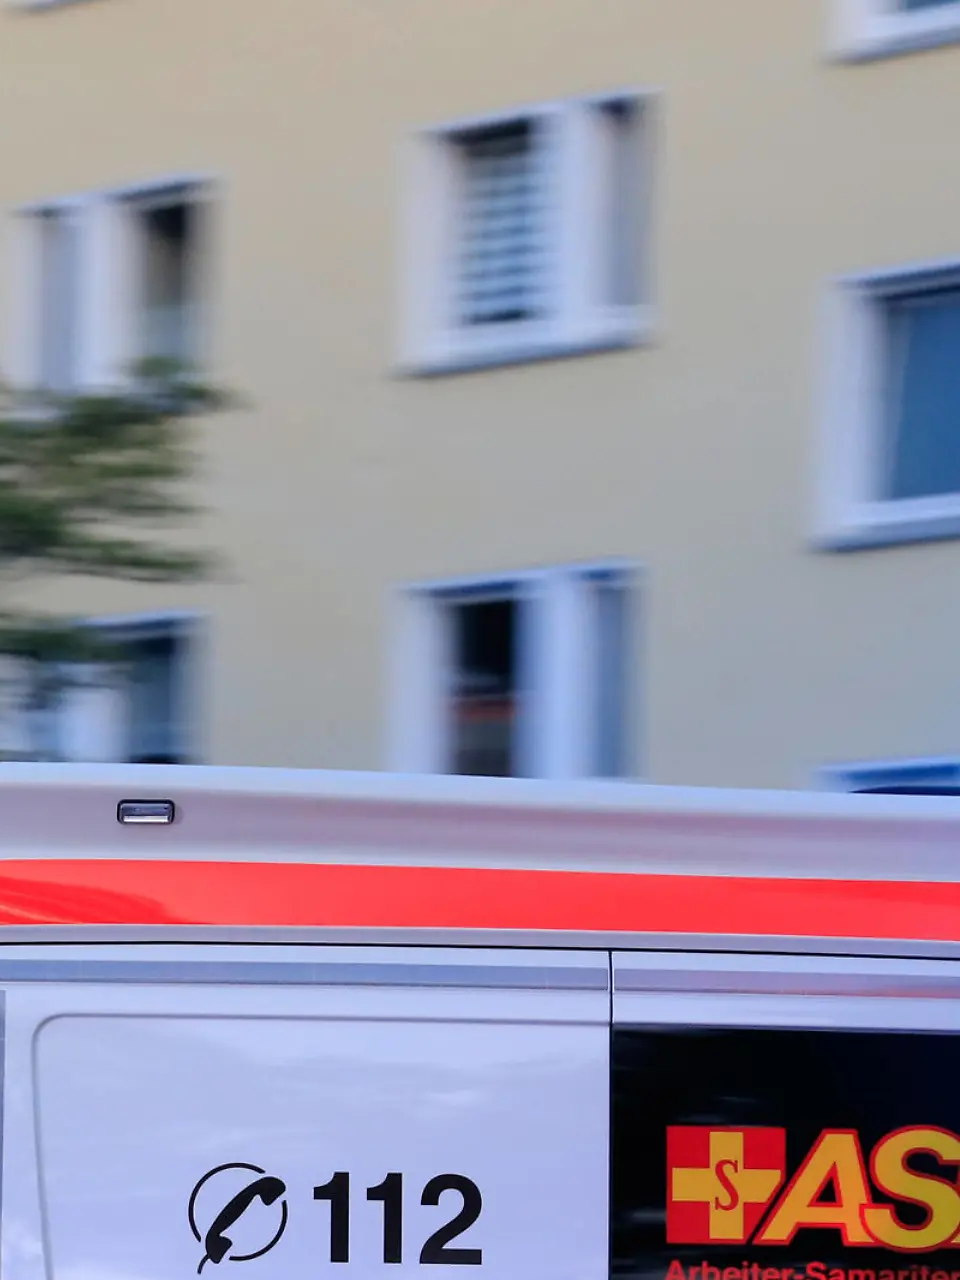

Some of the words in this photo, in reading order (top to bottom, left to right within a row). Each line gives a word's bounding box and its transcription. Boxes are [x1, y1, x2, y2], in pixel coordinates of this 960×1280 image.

[313, 1171, 483, 1265] 112
[714, 1159, 740, 1211] S
[751, 1124, 960, 1254] AS
